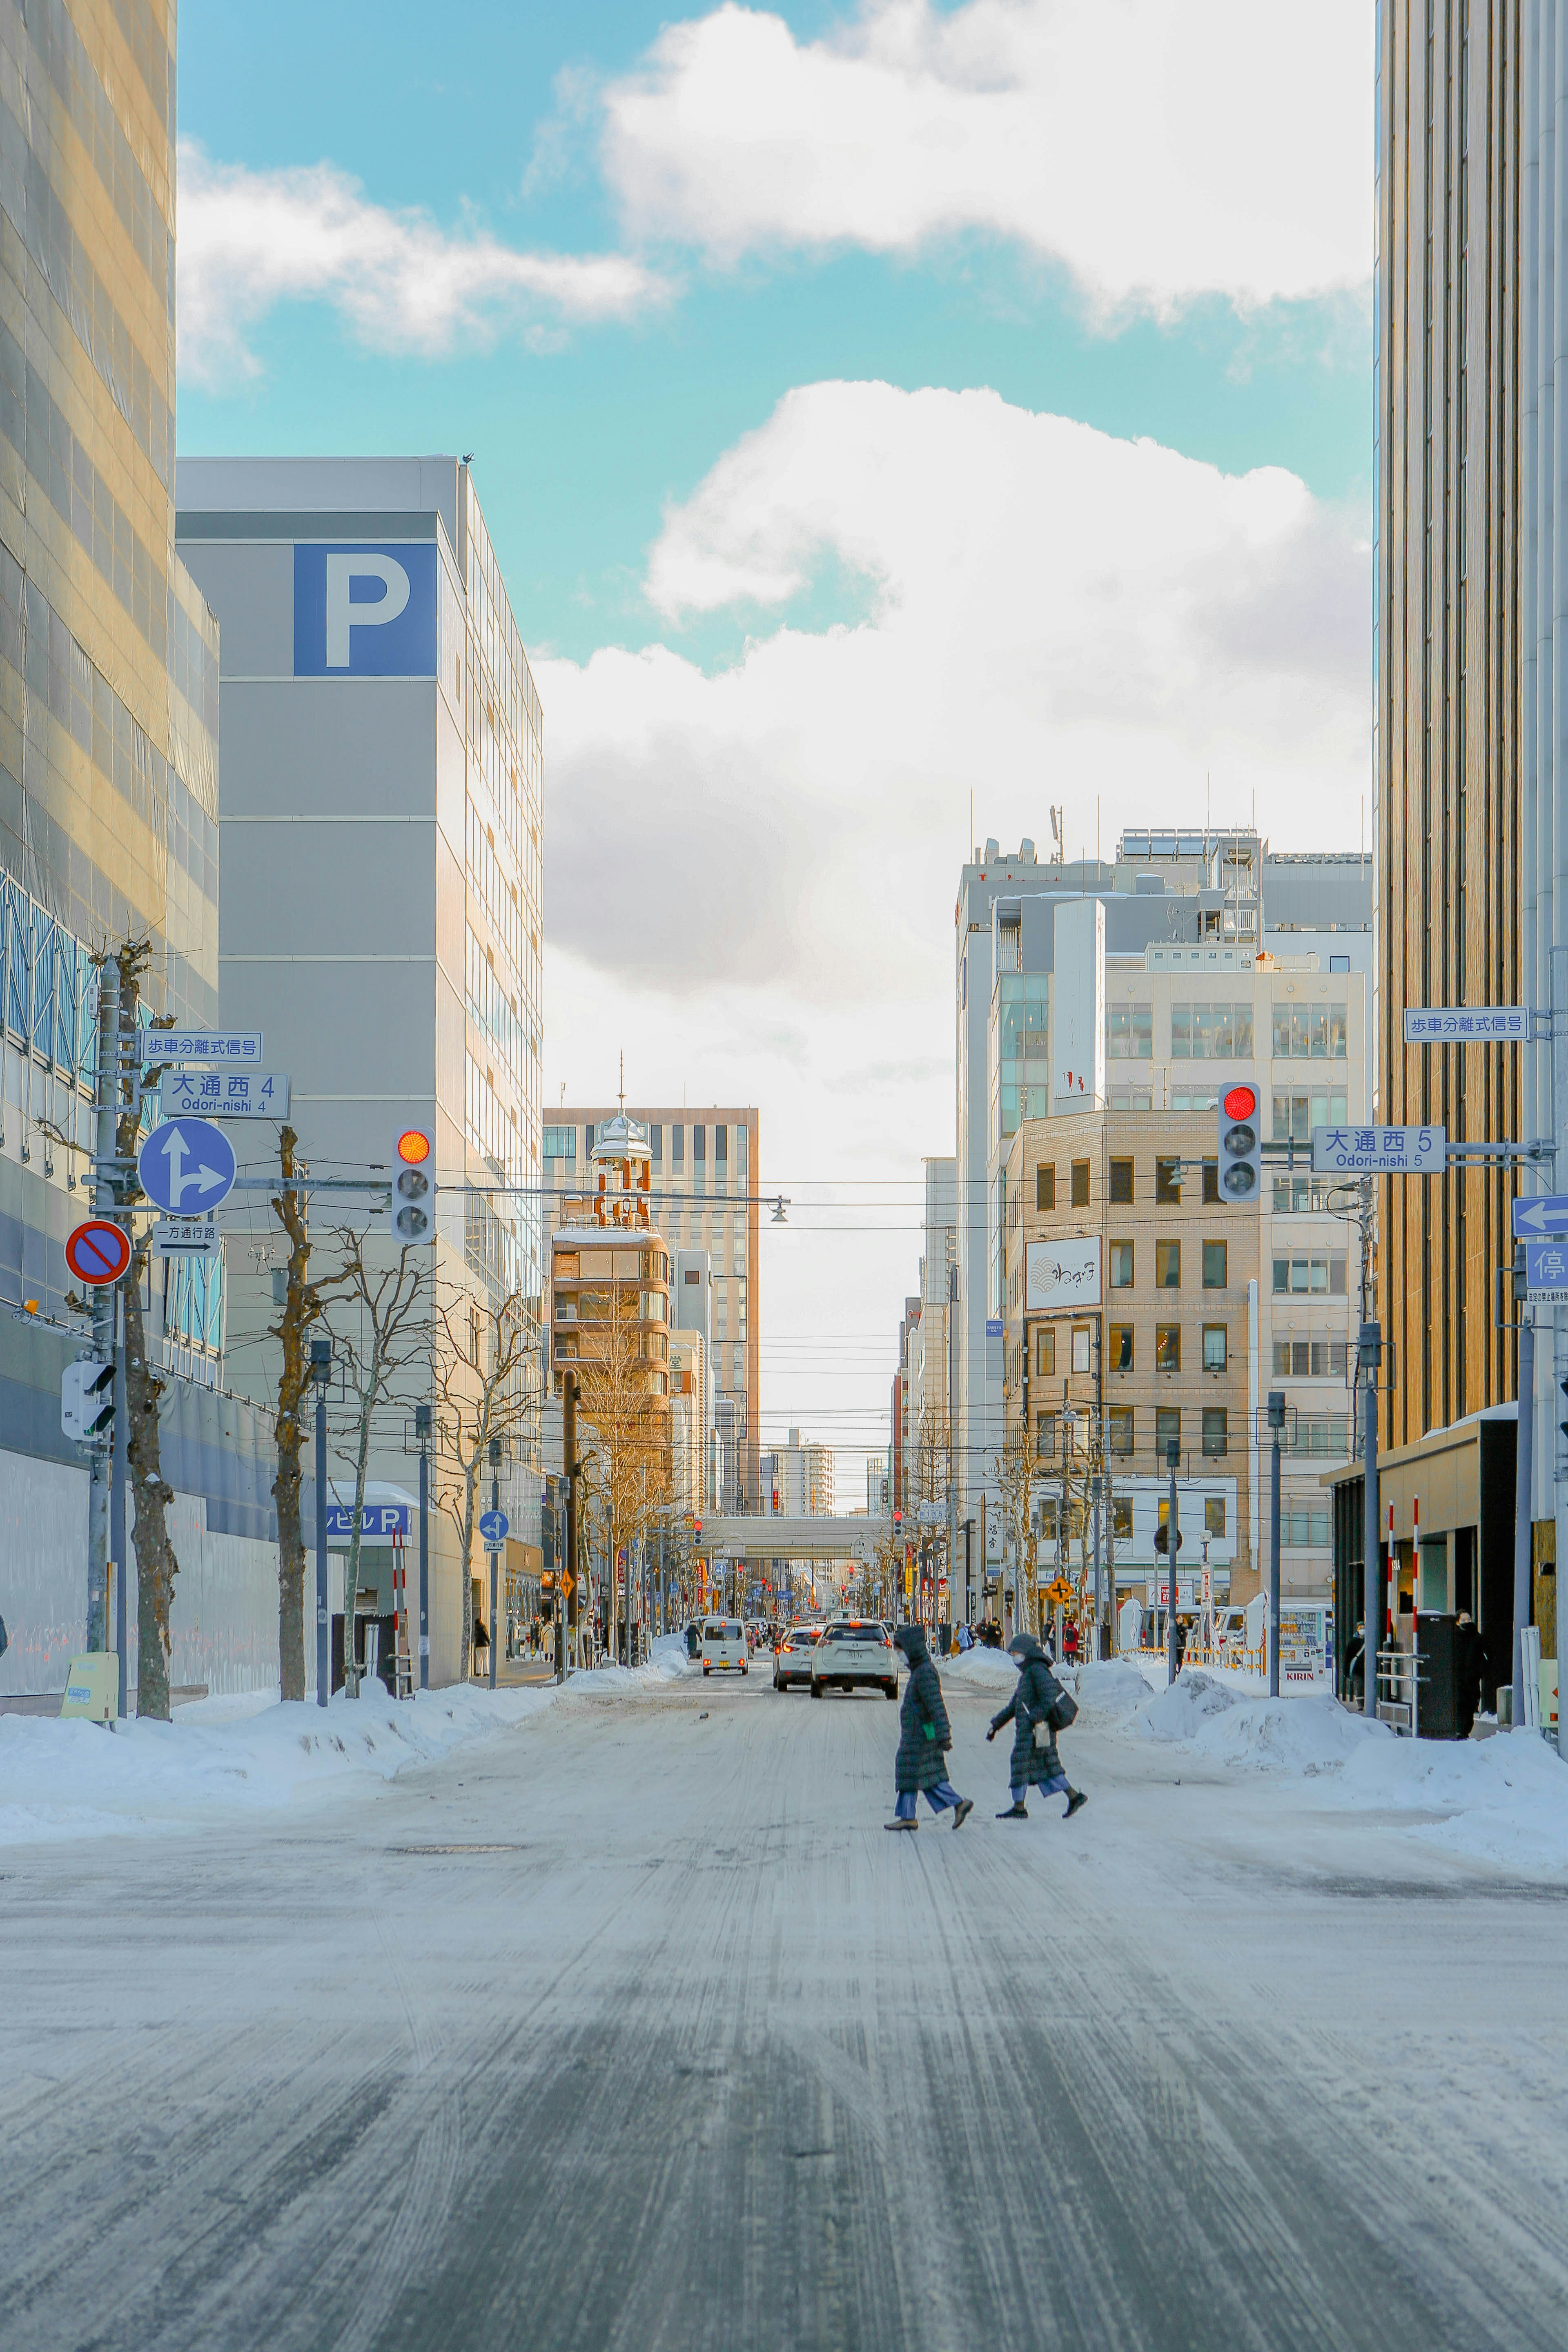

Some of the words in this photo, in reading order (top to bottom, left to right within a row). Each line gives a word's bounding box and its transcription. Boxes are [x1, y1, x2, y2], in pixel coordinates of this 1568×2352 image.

[326, 553, 410, 667] P
[1411, 1016, 1522, 1033] 歩車分離式信号
[148, 1038, 256, 1055] 歩車分離式信号
[172, 1074, 250, 1097] 大通西
[261, 1076, 274, 1098] 4
[181, 1098, 252, 1112] Odori-nishi
[258, 1100, 266, 1112] 4
[1325, 1130, 1405, 1152] 大通西
[1418, 1130, 1432, 1152] 5
[1336, 1154, 1408, 1167] Odori-nishi
[1414, 1155, 1422, 1167] 5
[157, 1227, 215, 1239] 一方通行路
[1534, 1250, 1565, 1280] 停
[381, 1509, 400, 1532] P
